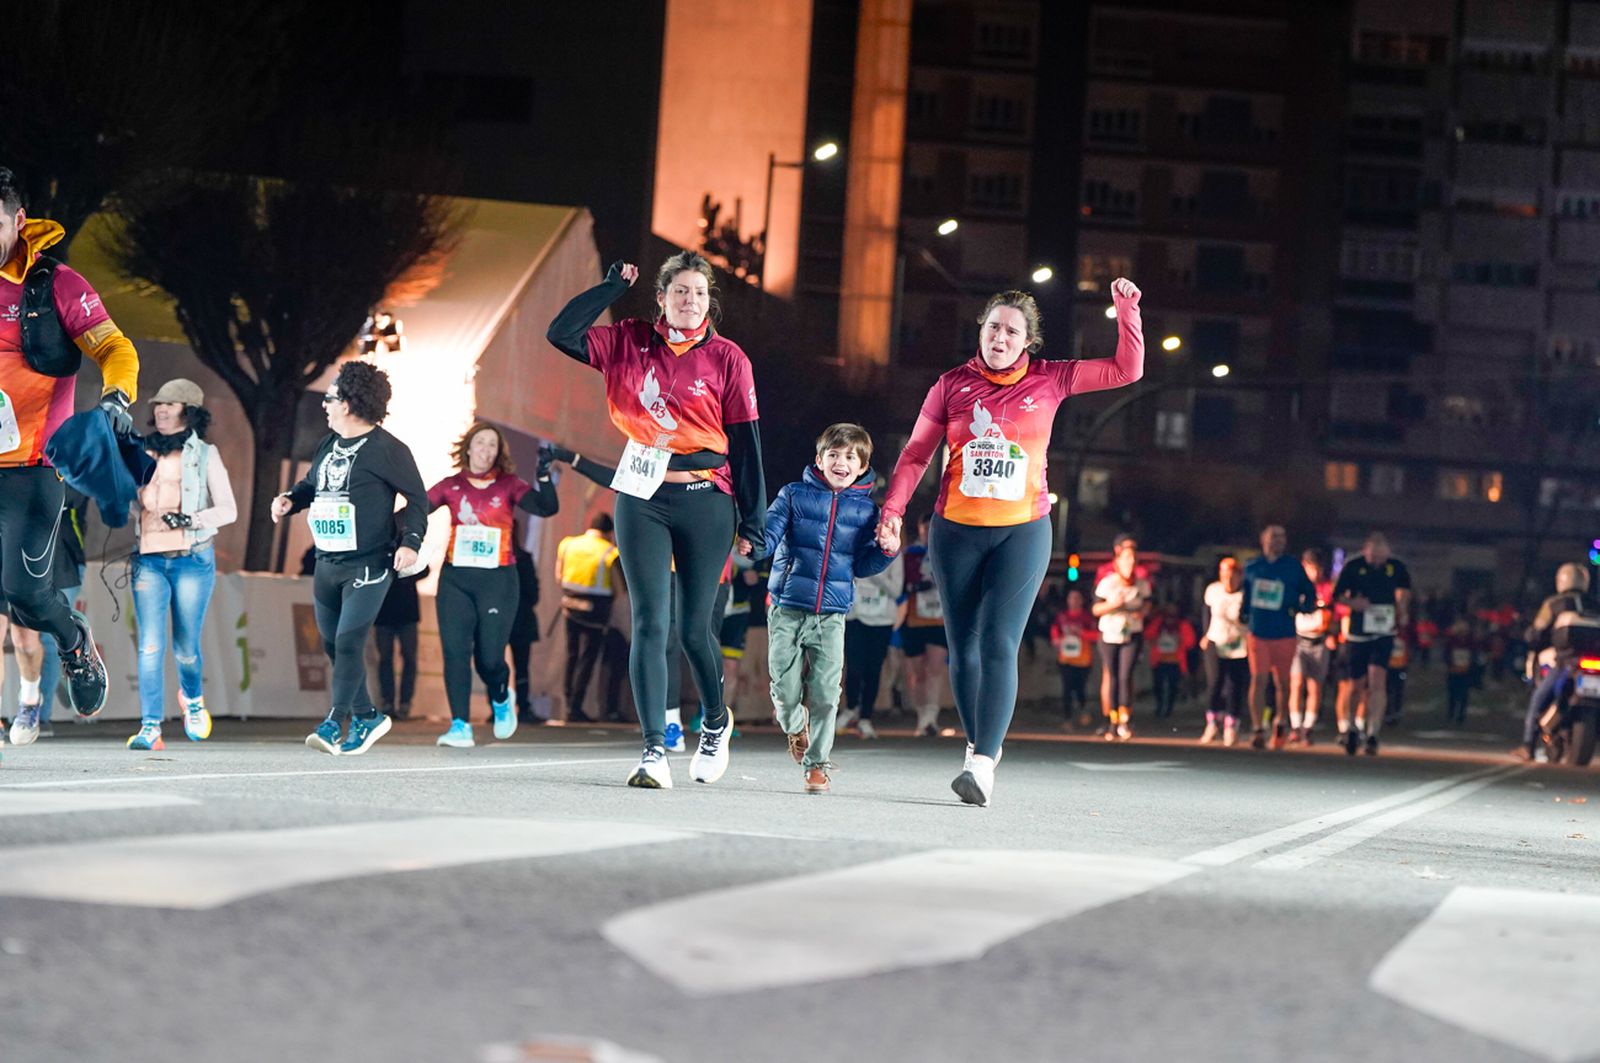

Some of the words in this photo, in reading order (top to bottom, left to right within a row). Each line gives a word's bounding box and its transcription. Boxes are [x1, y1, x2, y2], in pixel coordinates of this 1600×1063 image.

[650, 400, 666, 419] 43
[630, 454, 657, 479] 3341
[973, 458, 1015, 479] 3340
[686, 481, 711, 491] NIKE
